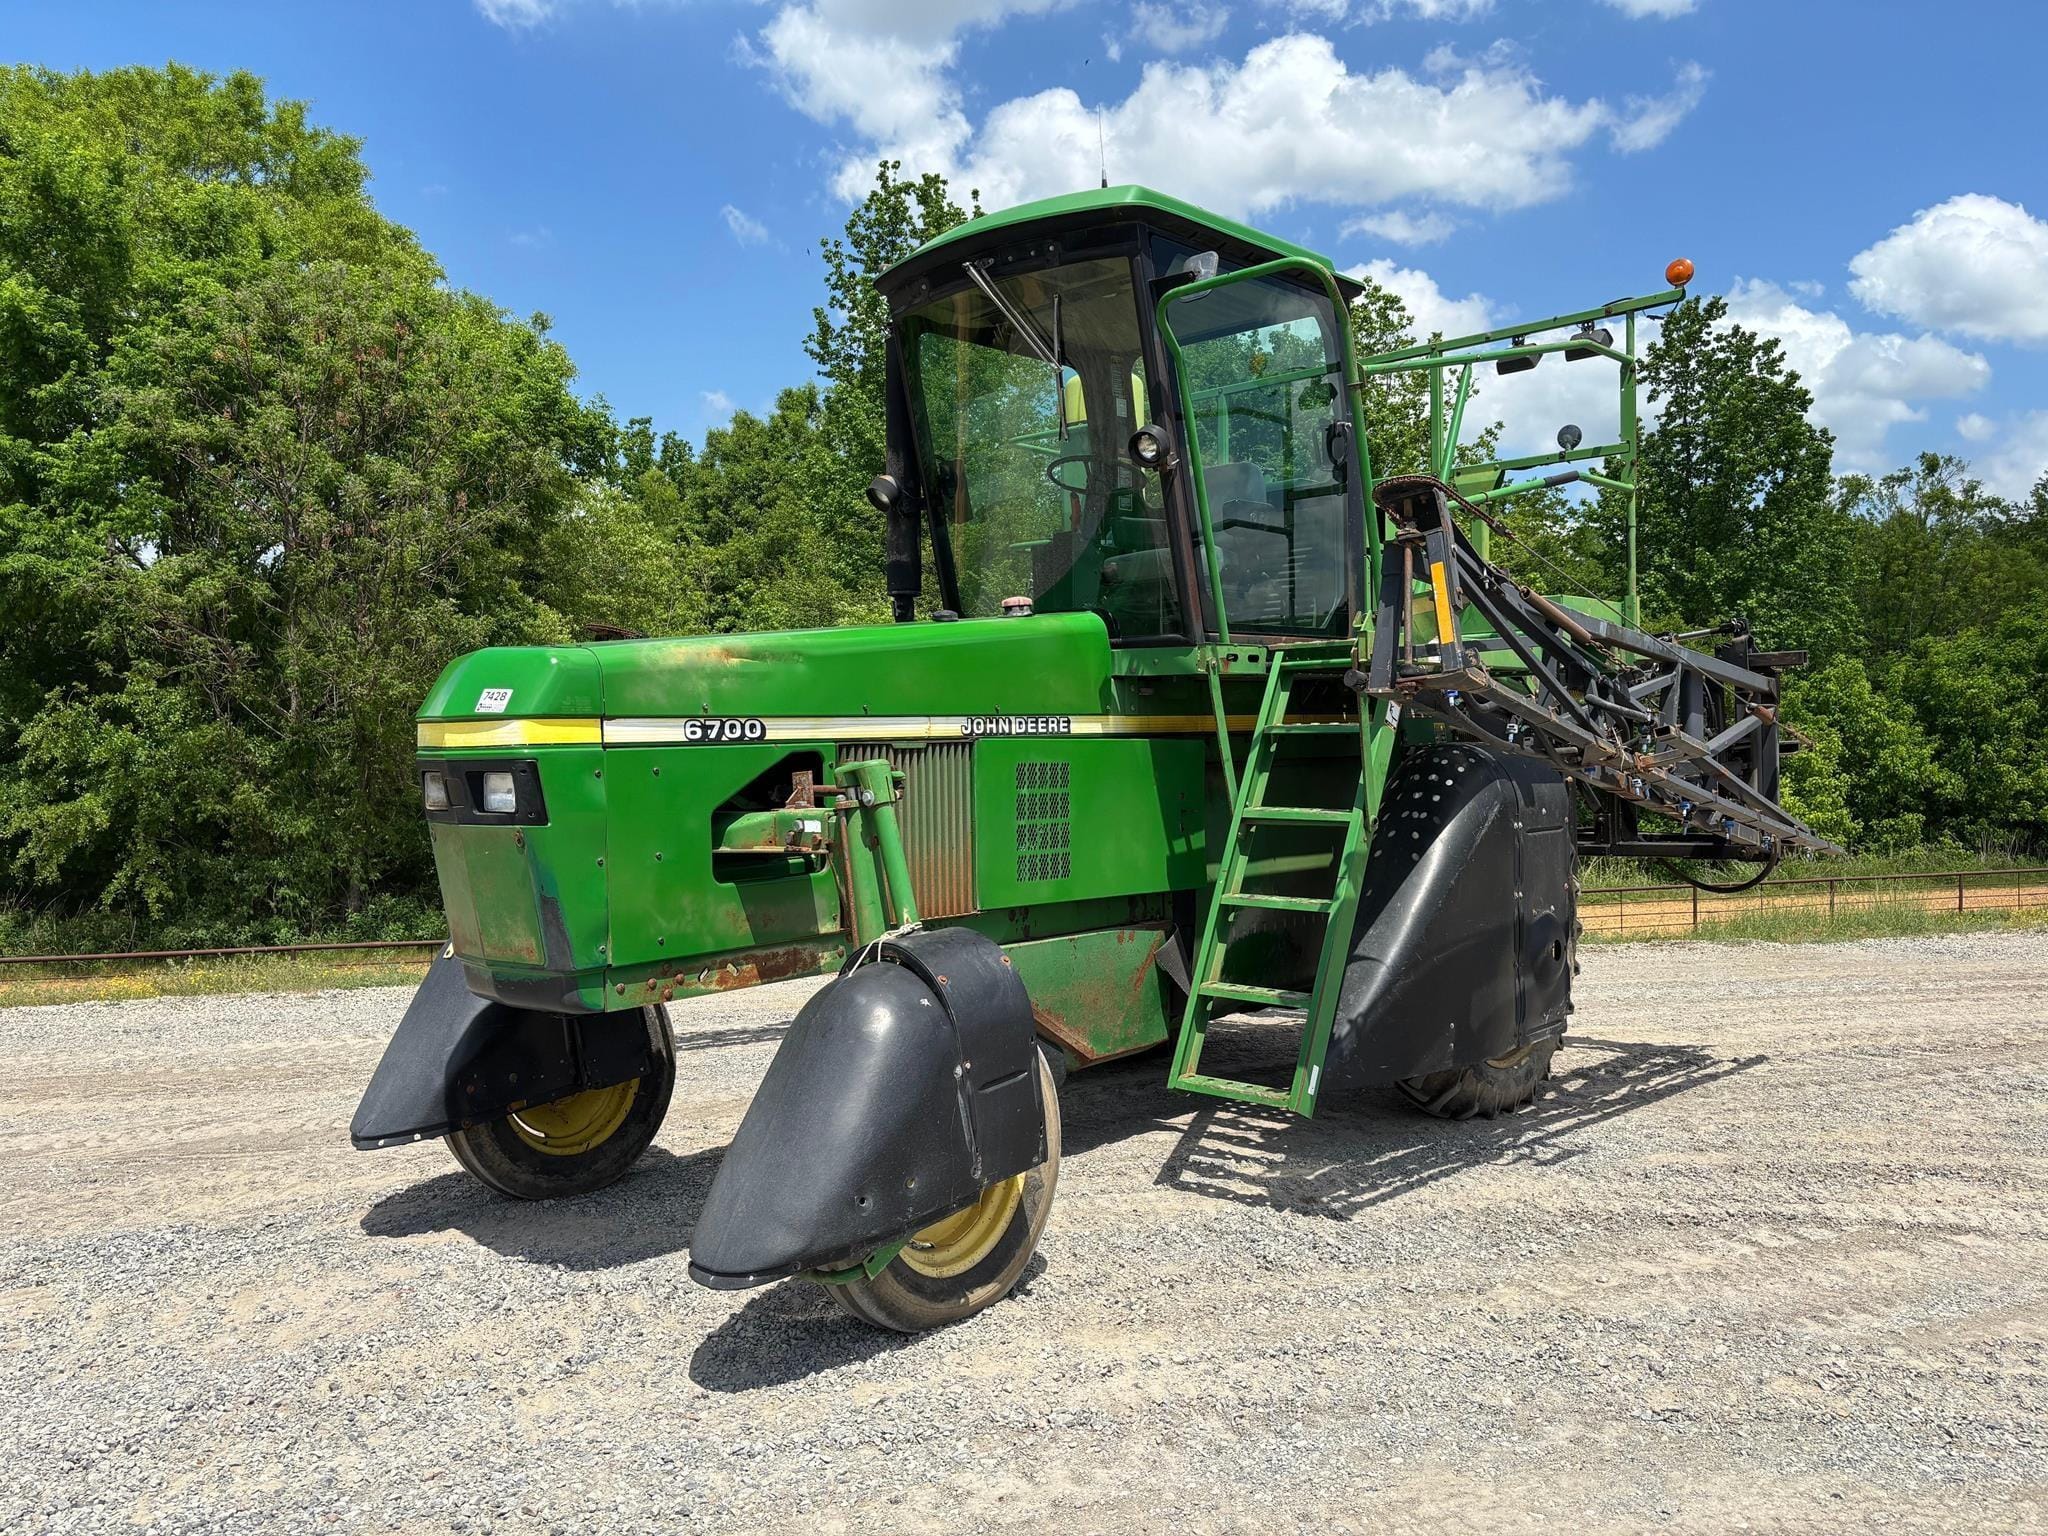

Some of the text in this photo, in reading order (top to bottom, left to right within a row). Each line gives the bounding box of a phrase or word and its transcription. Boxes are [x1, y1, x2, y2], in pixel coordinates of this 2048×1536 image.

[483, 691, 508, 701] 7428
[684, 719, 764, 740] 6700
[961, 717, 1070, 735] JOHN DEERE
